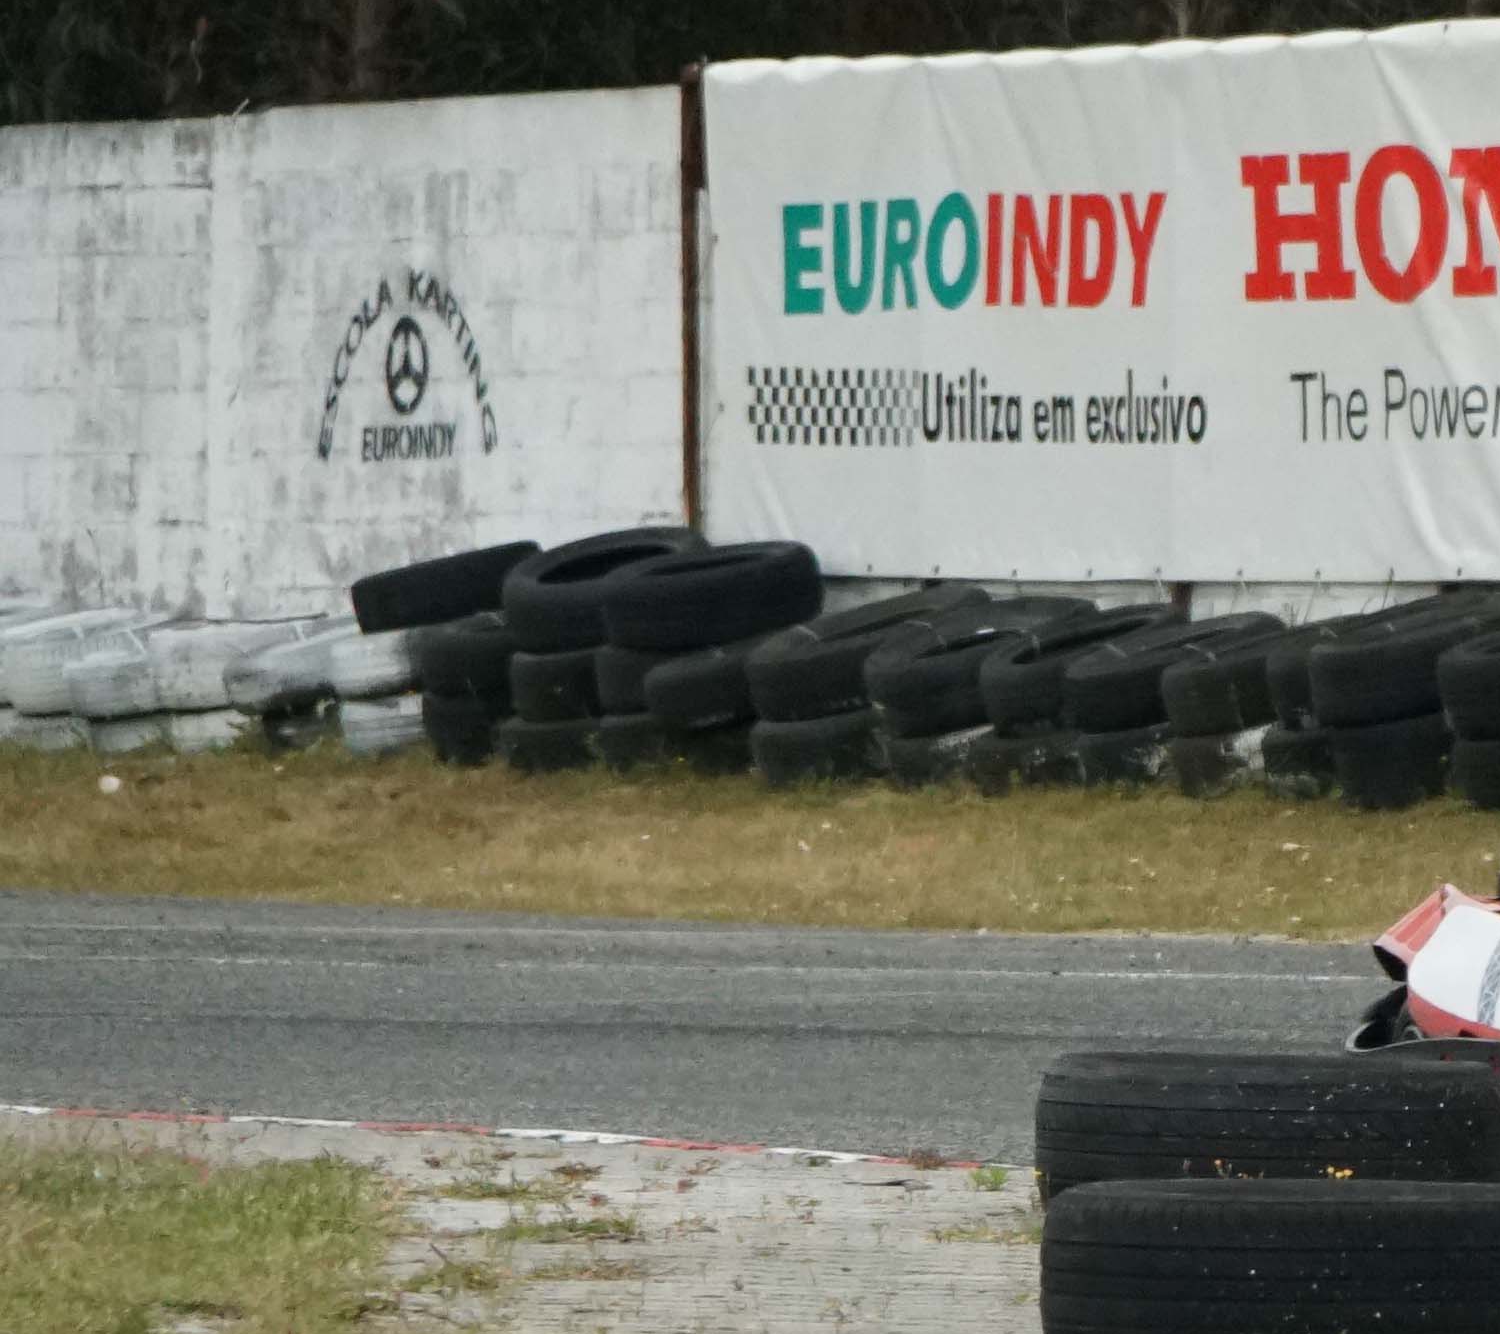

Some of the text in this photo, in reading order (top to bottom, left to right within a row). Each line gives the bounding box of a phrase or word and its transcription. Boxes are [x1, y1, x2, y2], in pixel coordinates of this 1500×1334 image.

[782, 192, 1167, 315] EUROINDY
[361, 423, 456, 462] EUROINDY
[920, 369, 1208, 445] Utiliza em exclusivo
[1290, 370, 1368, 442] The
